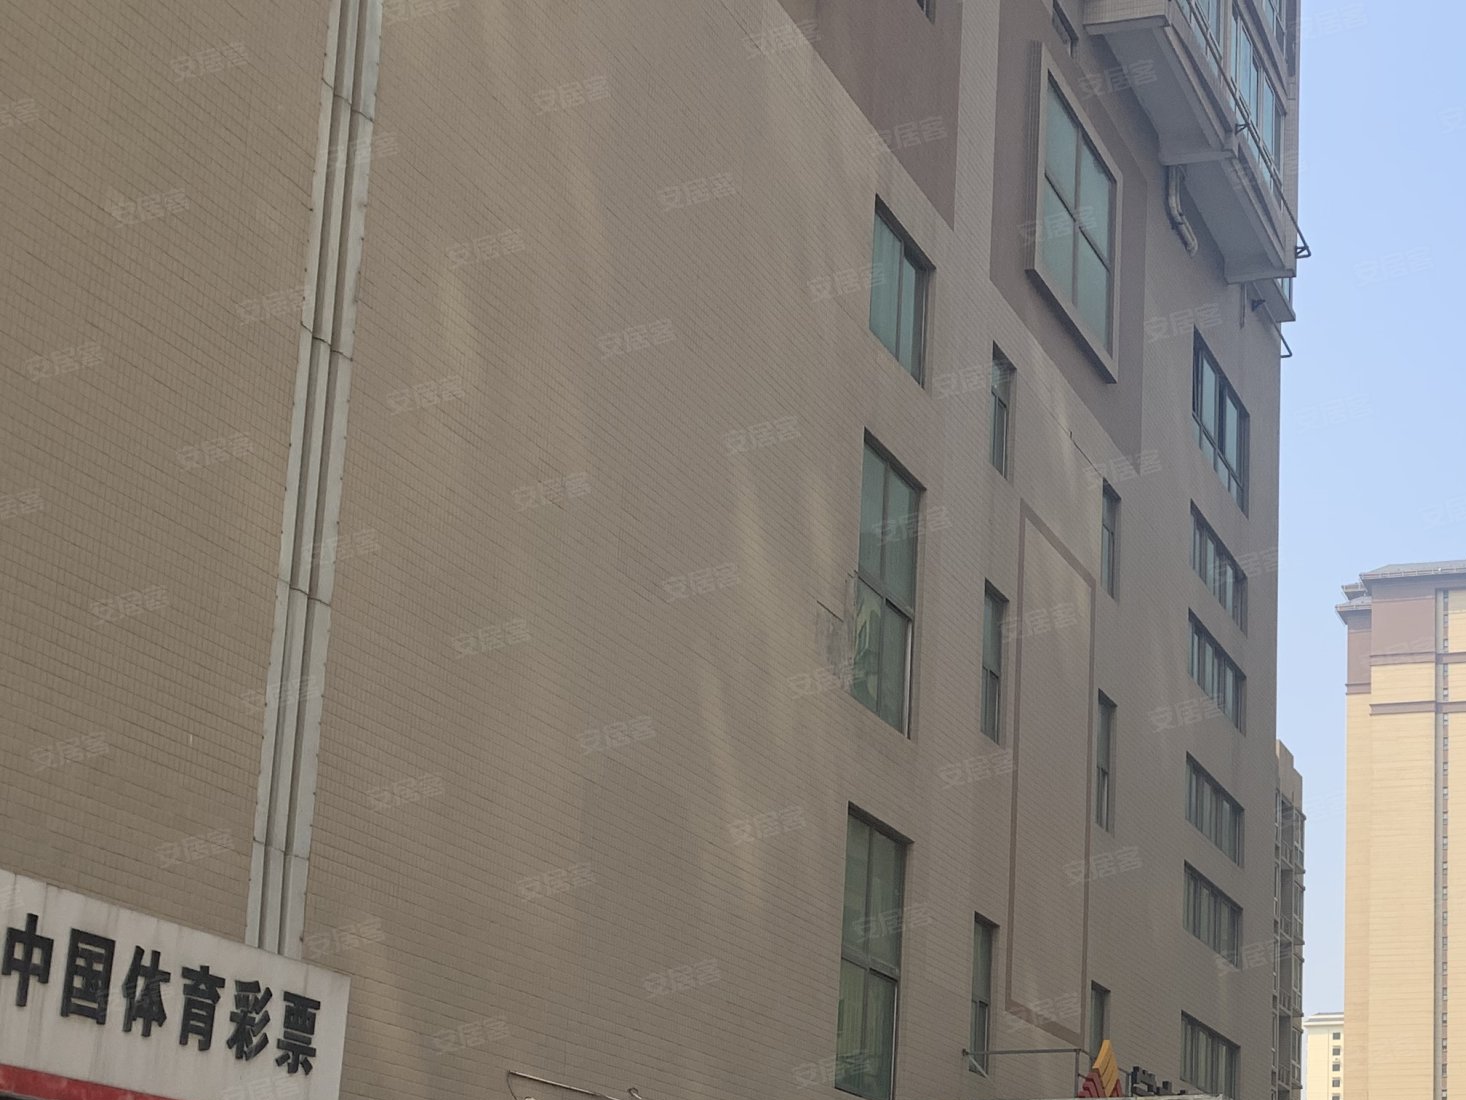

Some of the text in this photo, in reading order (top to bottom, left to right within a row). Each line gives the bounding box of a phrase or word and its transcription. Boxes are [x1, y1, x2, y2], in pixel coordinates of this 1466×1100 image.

[1, 912, 321, 1076] 中国体育彩票
